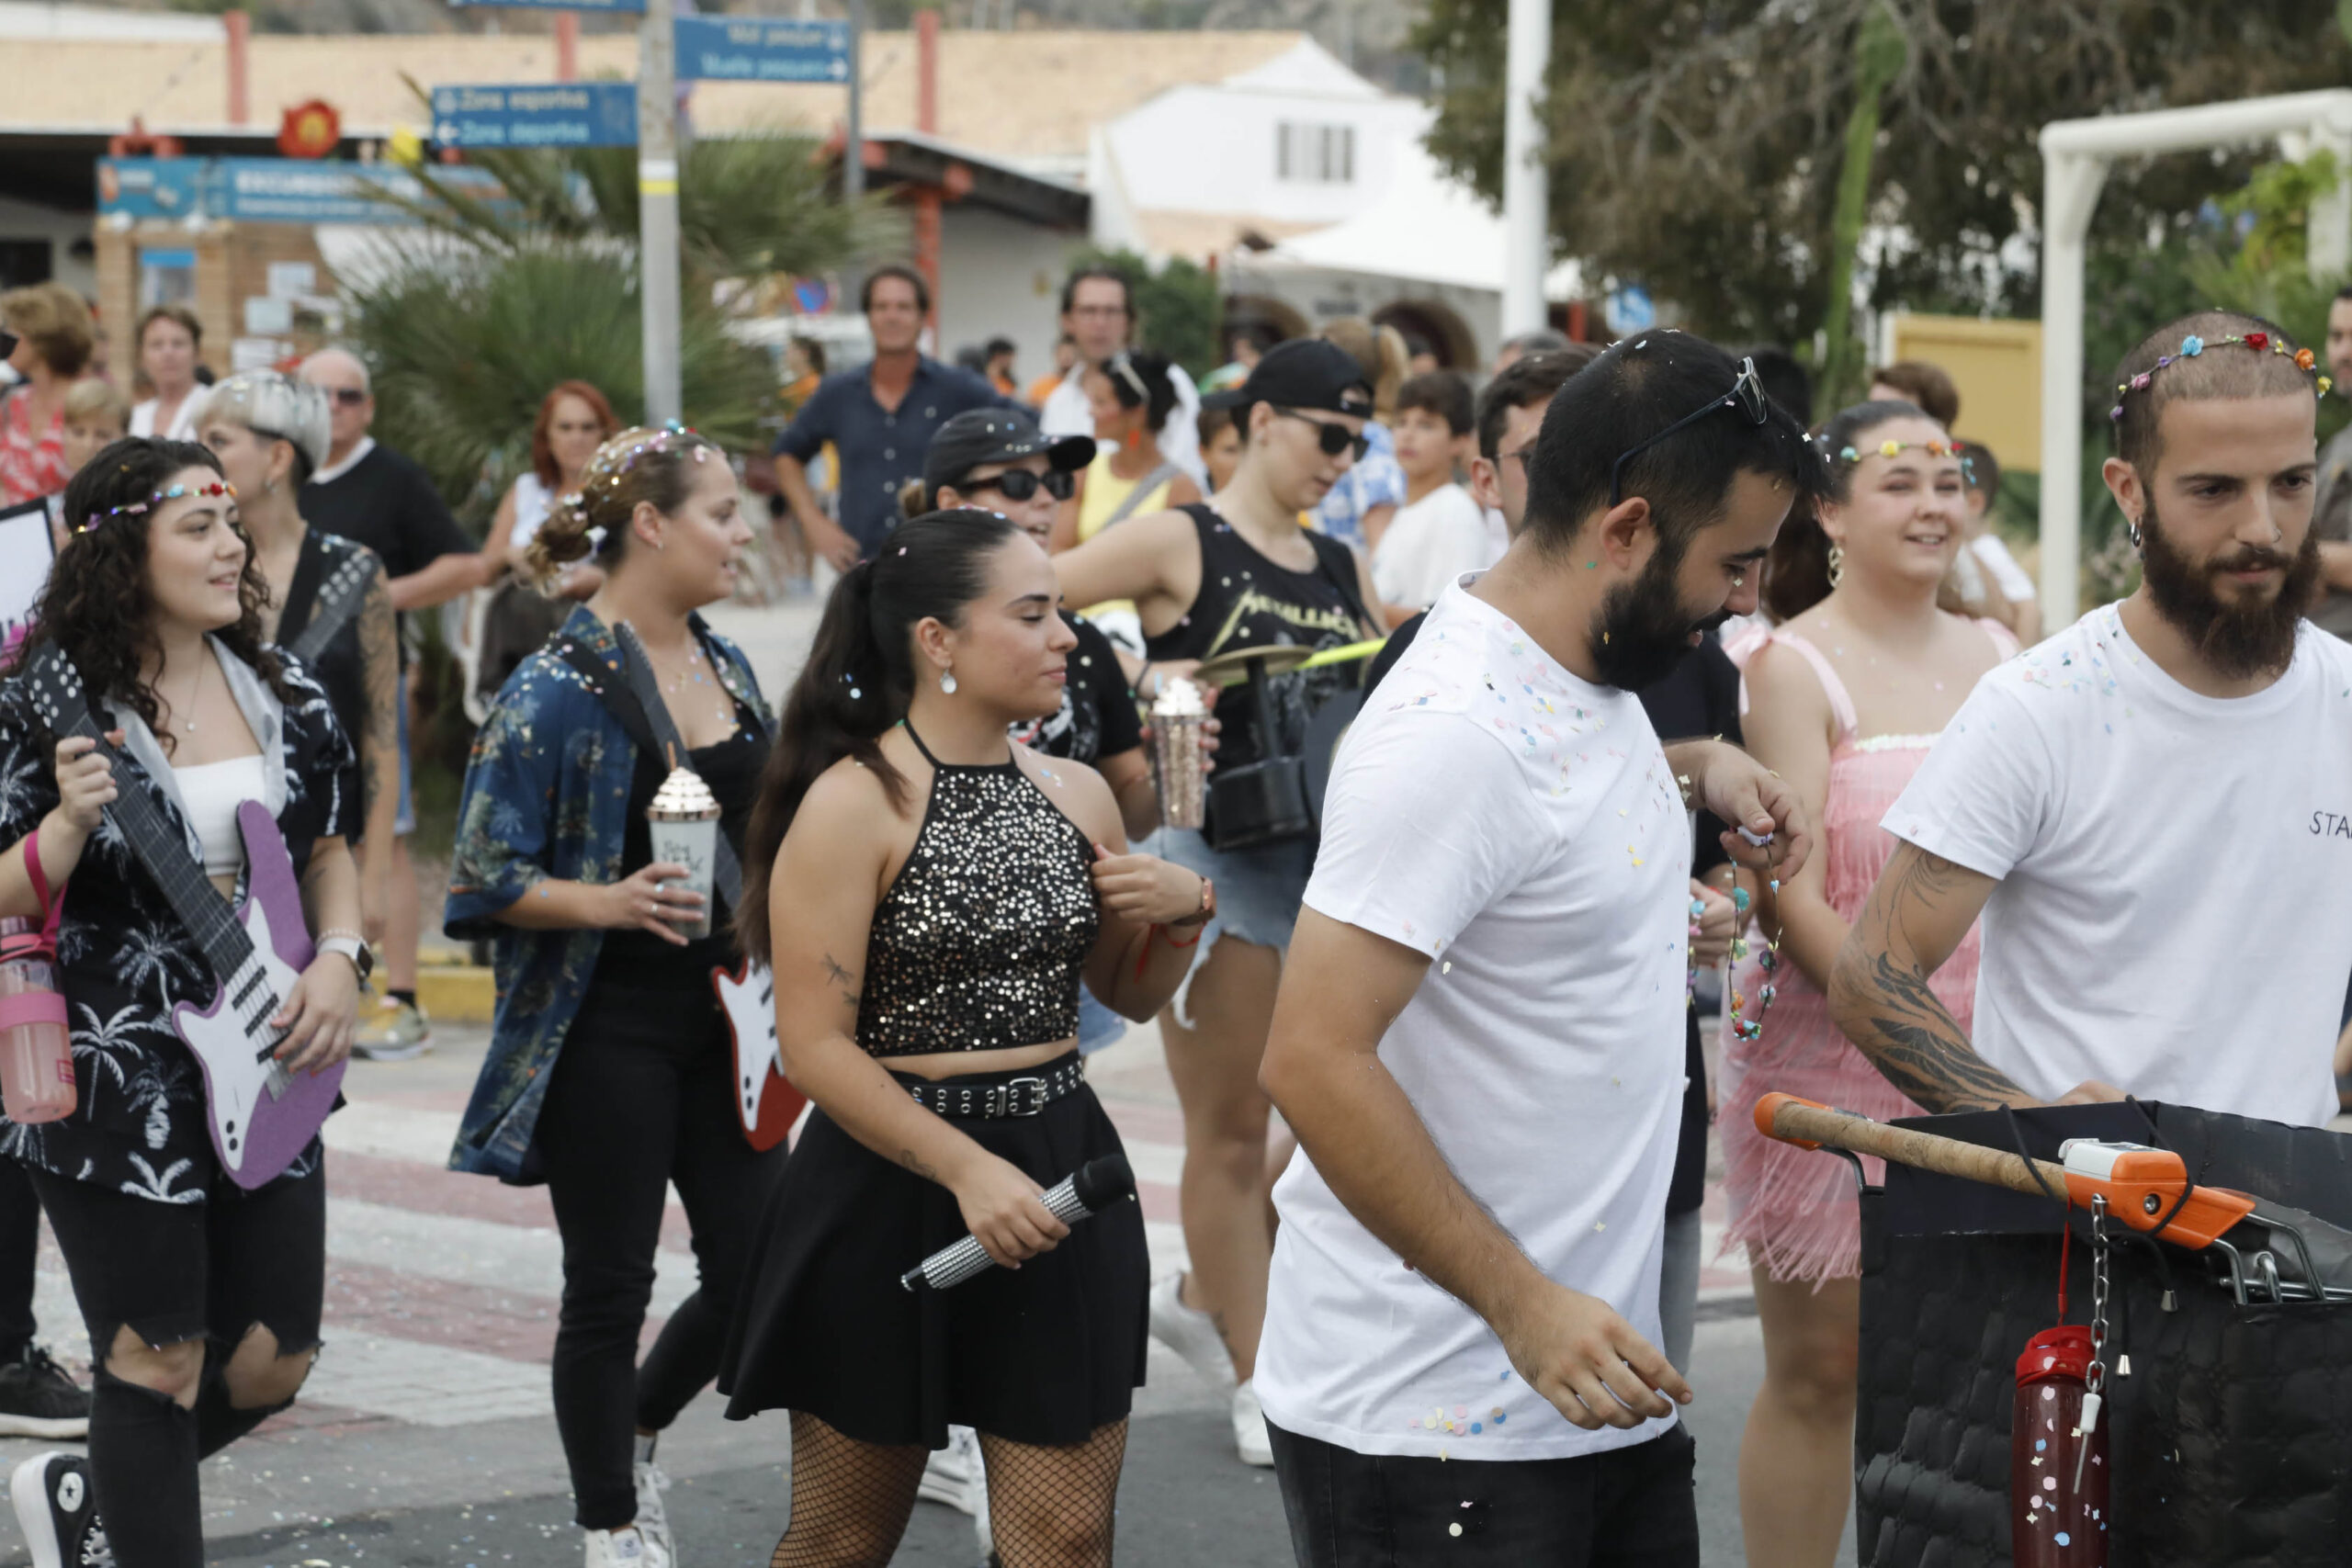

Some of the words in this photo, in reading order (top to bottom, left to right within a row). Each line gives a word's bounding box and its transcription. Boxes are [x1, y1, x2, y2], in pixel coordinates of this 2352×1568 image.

[460, 88, 503, 111] Zona
[509, 89, 590, 113] esportiva
[460, 119, 504, 144] Zona
[510, 120, 590, 145] deportiva
[2309, 809, 2352, 840] STA
